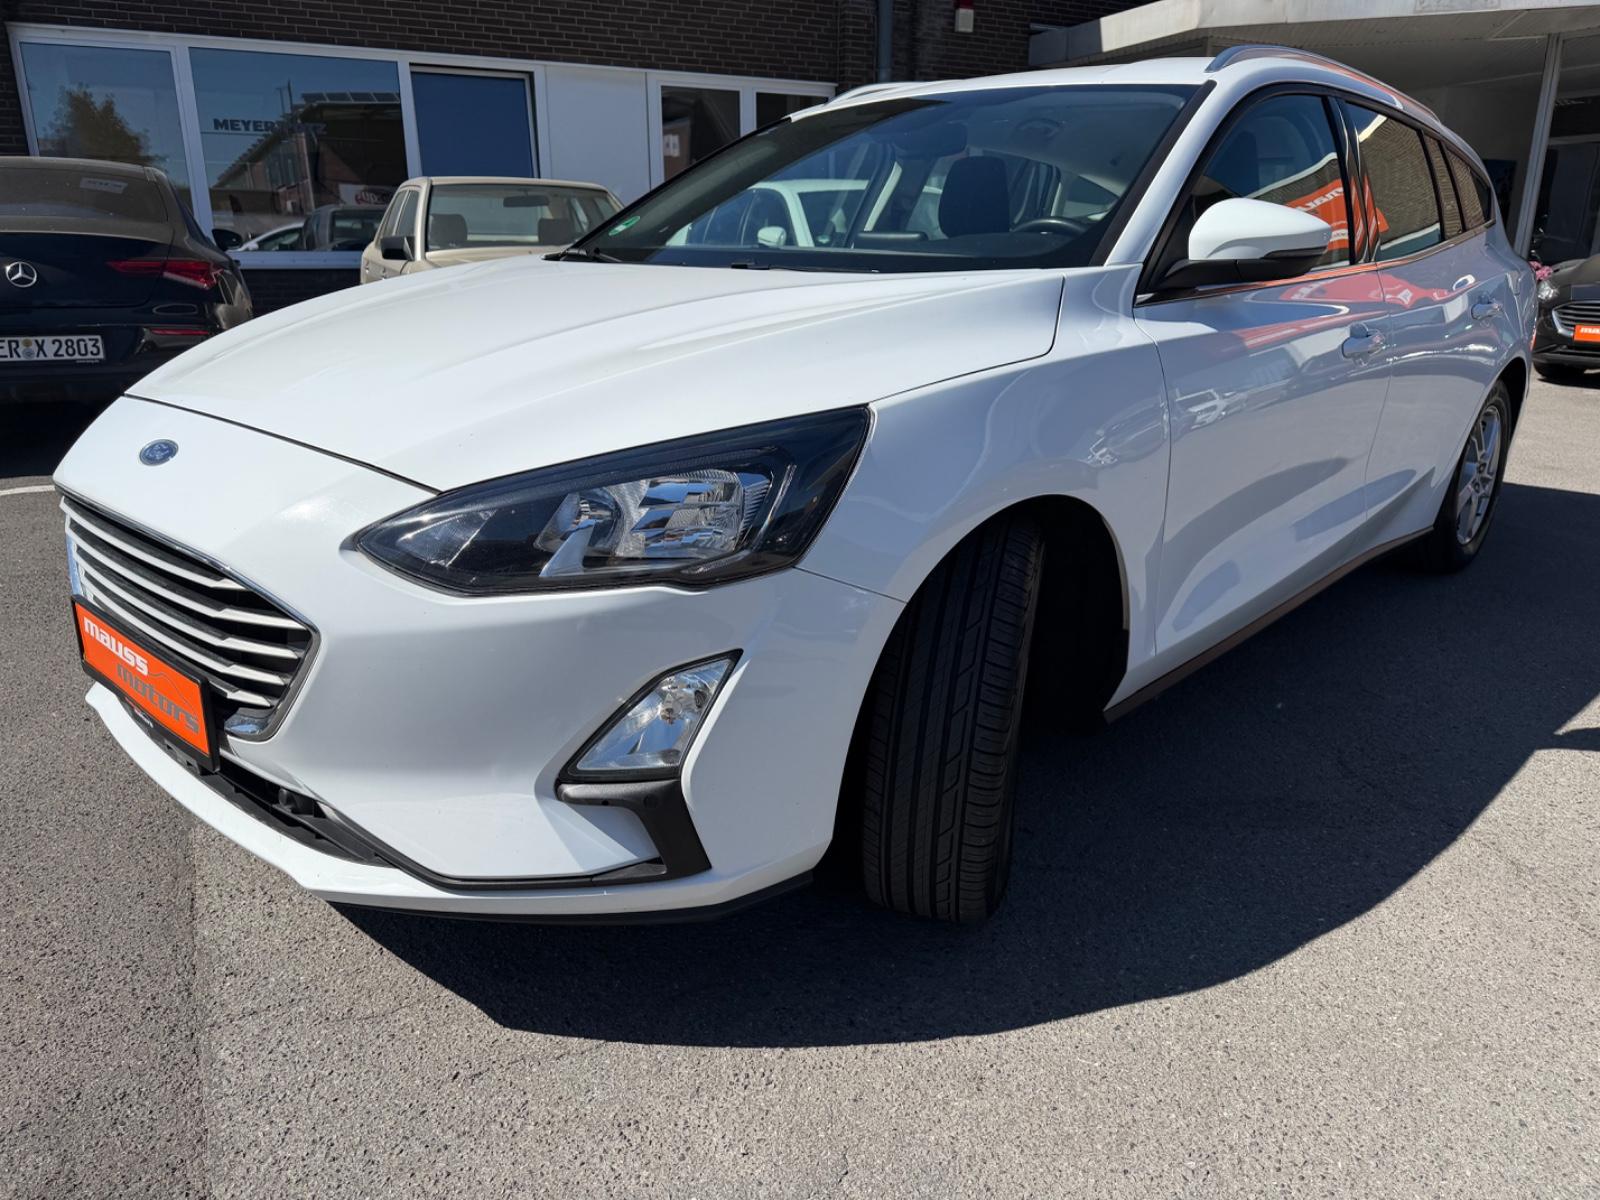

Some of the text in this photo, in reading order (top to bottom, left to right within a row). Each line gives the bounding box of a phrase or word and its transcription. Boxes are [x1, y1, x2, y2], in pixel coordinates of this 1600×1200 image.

[34, 339, 47, 358] X
[52, 338, 100, 357] 2803
[83, 617, 149, 677] mauss
[117, 663, 199, 735] motors
